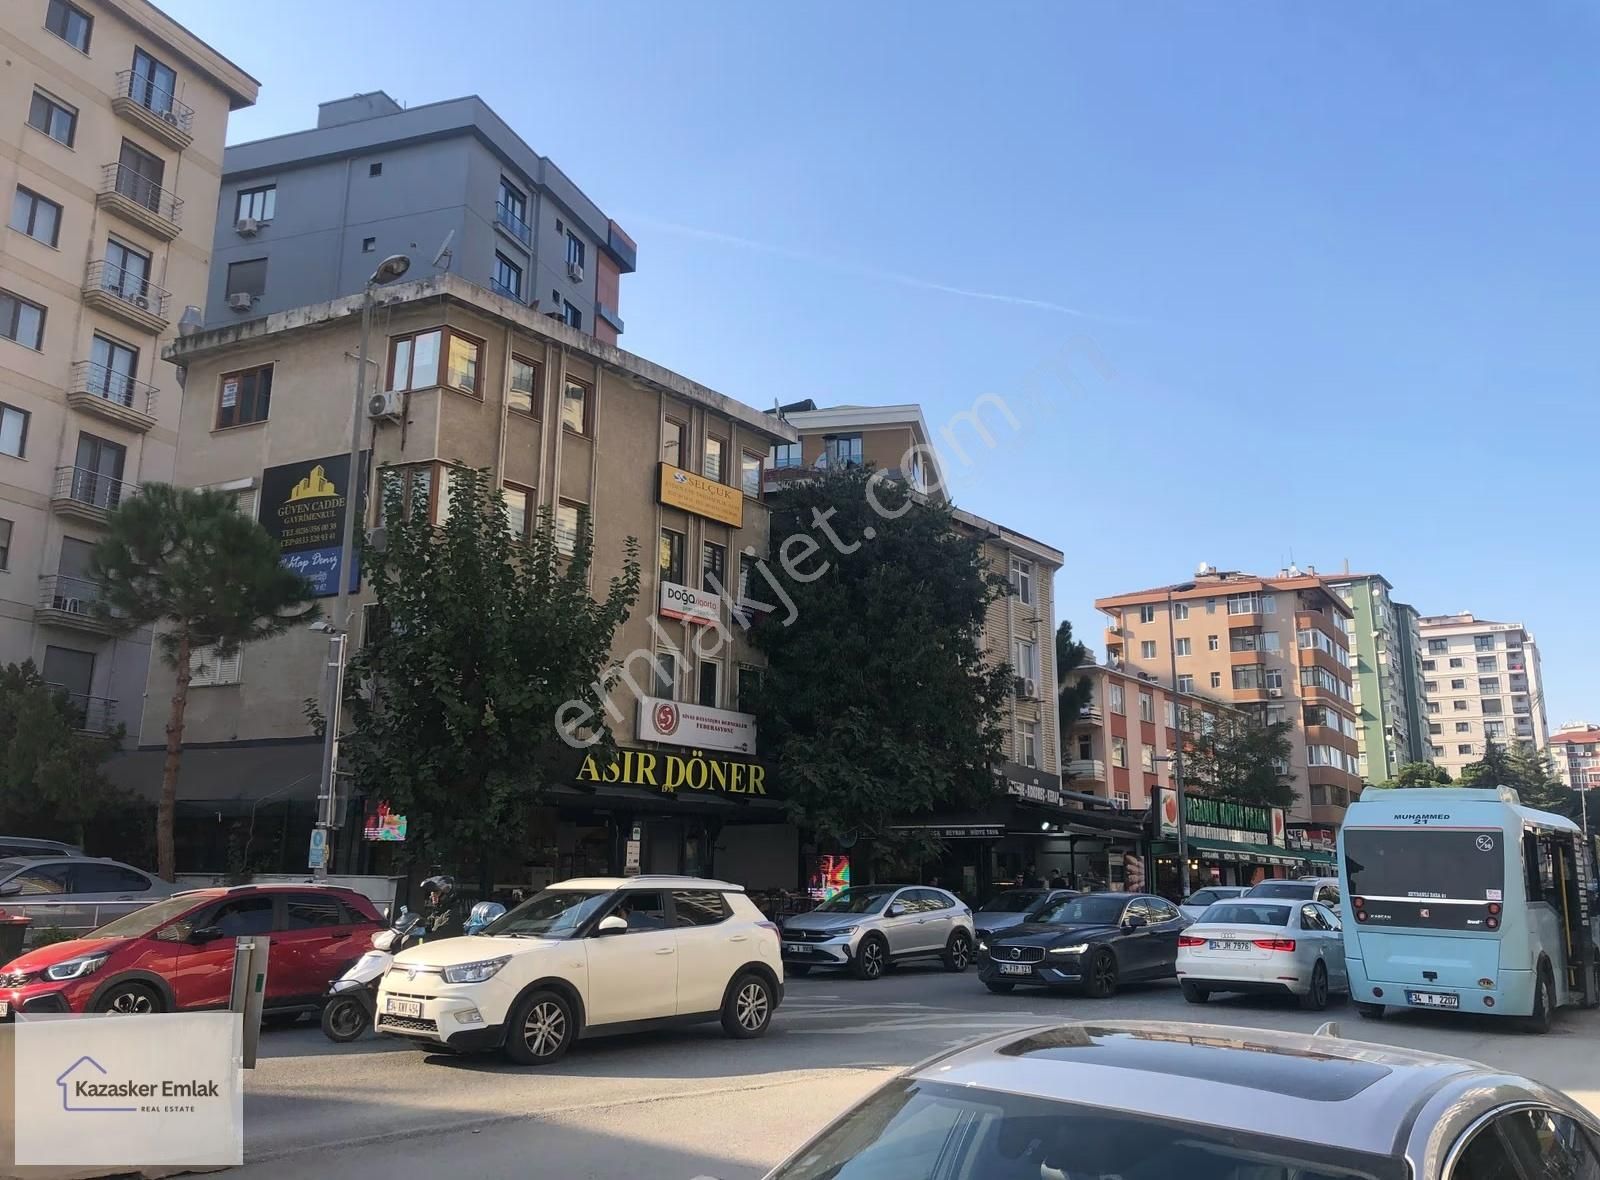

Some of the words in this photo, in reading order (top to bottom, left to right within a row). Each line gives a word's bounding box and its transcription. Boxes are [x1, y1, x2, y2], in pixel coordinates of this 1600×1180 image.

[278, 502, 311, 517] GÜVEN
[312, 497, 346, 512] CADDE
[664, 750, 767, 795] DÖNER
[1412, 993, 1421, 1001] 34
[1439, 996, 1457, 1005] 2207
